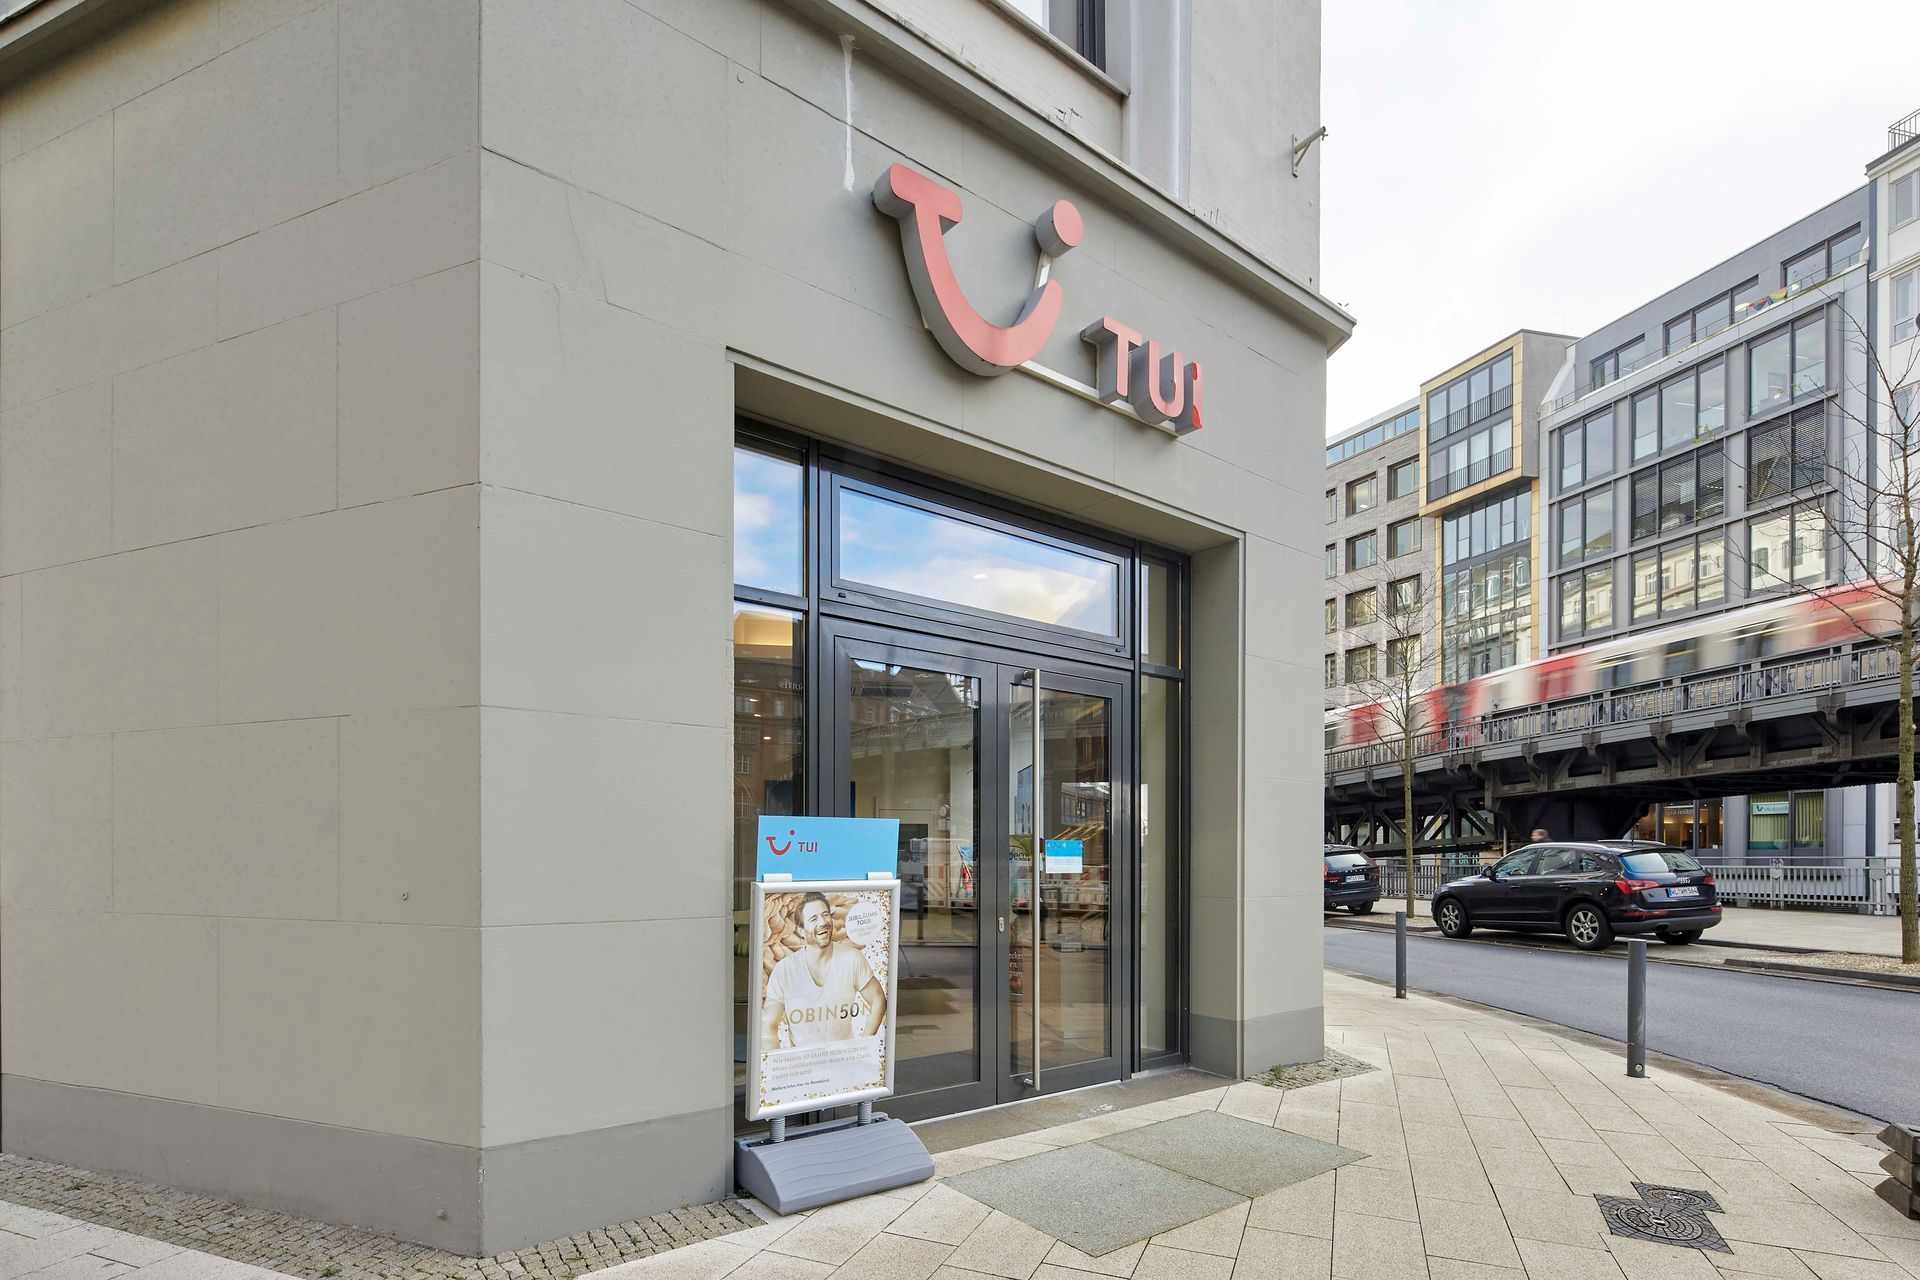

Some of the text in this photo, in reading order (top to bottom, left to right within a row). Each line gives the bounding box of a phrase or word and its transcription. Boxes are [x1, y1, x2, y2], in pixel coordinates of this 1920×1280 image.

[1098, 315, 1204, 432] TUI
[798, 841, 819, 853] TUI
[856, 918, 872, 926] TOUR
[830, 1047, 859, 1057] ROBINSON
